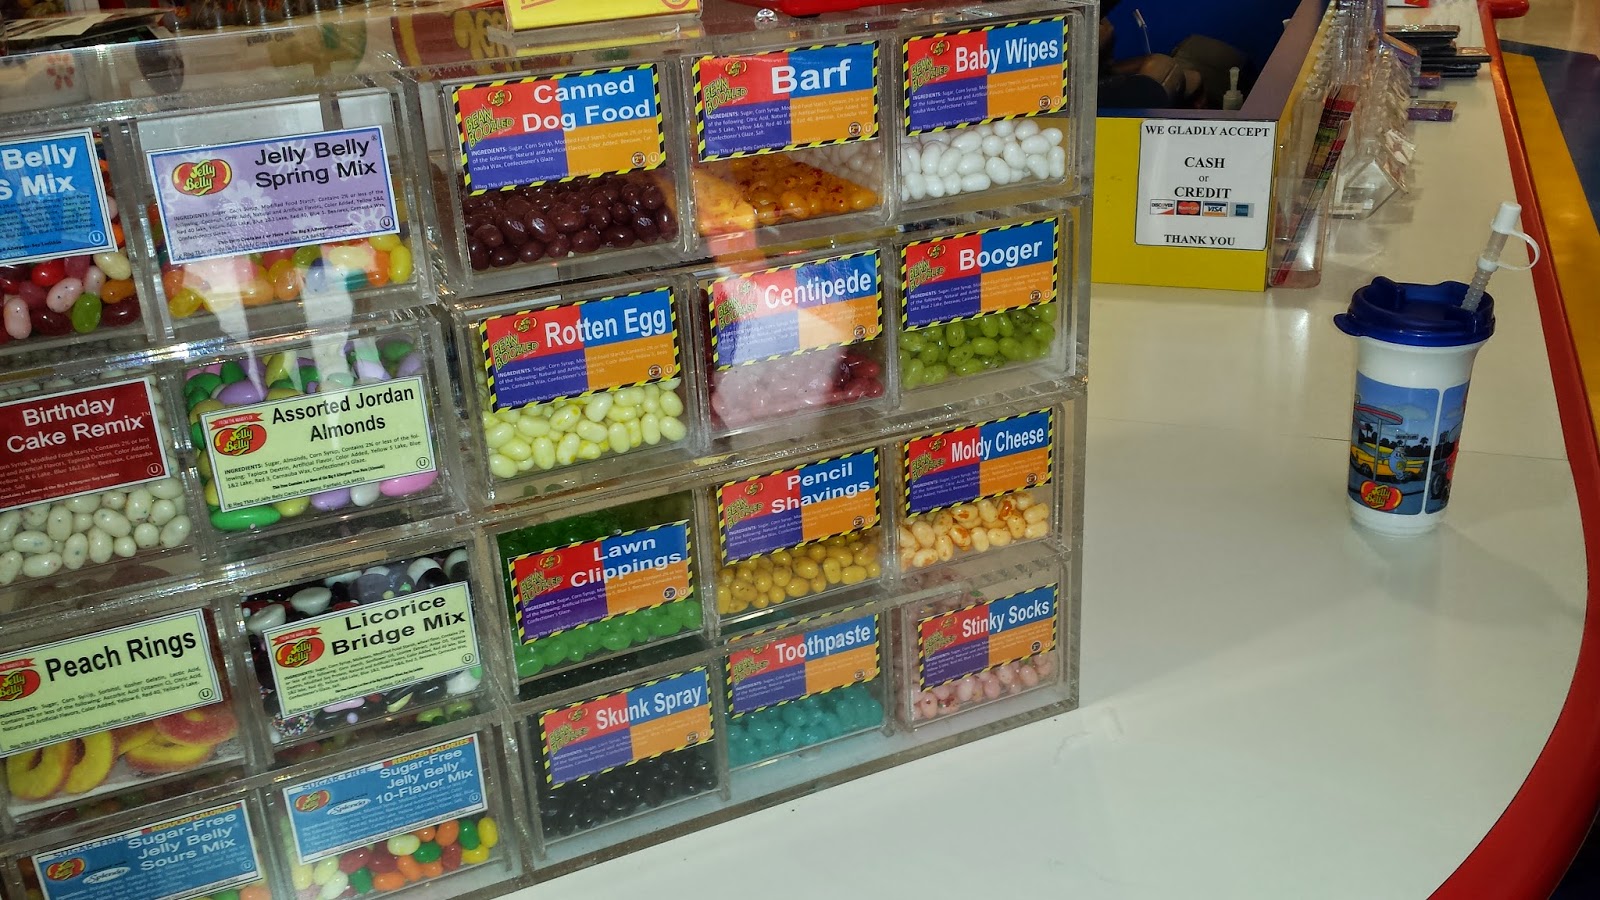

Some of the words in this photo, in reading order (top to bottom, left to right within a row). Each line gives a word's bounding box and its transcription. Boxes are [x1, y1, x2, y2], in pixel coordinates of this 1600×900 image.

[955, 43, 1000, 74] Baby
[1005, 37, 1058, 68] Wipes
[533, 75, 635, 104] Canned
[703, 77, 730, 101] BEAN
[771, 58, 852, 94] Barf
[464, 106, 494, 133] BEAN
[522, 112, 577, 132] Dog
[584, 99, 650, 124] Food
[1145, 125, 1164, 135] WE
[1167, 125, 1217, 136] GLADLY
[1219, 126, 1270, 137] ACCEPT
[1, 143, 77, 170] Belly
[190, 162, 217, 179] Jelly
[255, 146, 306, 166] Jelly
[1184, 156, 1225, 169] CASH
[21, 173, 76, 197] Mix
[183, 177, 213, 193] Belly
[255, 168, 330, 190] Spring
[336, 160, 377, 178] Mix
[1174, 186, 1231, 199] CREDIT
[1164, 234, 1206, 245] THANK
[1210, 236, 1235, 246] YOU
[959, 240, 1043, 271] Booger
[764, 268, 872, 309] Centipede
[544, 317, 618, 348] Rotten
[623, 307, 666, 337] Egg
[491, 333, 519, 358] BEAN
[22, 397, 115, 426] Birthday
[272, 395, 351, 425] Assorted
[355, 387, 414, 409] Jordan
[6, 430, 67, 453] Cake
[230, 426, 253, 442] Jelly
[310, 415, 386, 442] Almonds
[223, 439, 250, 453] Belly
[224, 463, 263, 475] INGREDIENTS:
[309, 451, 322, 459] Corn
[341, 443, 364, 453] Contains
[400, 434, 409, 442] the
[951, 436, 992, 463] Moldy
[995, 427, 1044, 452] Cheese
[247, 469, 268, 479] Tapioca
[292, 458, 315, 469] Artificial
[335, 453, 350, 461] Color
[370, 446, 388, 454] Yellow
[787, 461, 853, 491] Pencil
[255, 476, 267, 484] Red
[1372, 486, 1391, 499] Jelly
[771, 480, 871, 514] Shavings
[1366, 493, 1386, 505] Belly
[593, 537, 657, 562] Lawn
[570, 552, 682, 588] Clippings
[345, 597, 446, 631] Licorice
[962, 612, 1005, 638] Stinky
[1008, 599, 1050, 625] Socks
[291, 640, 313, 655] Jelly
[331, 625, 415, 656] Bridge
[423, 611, 466, 632] Mix
[775, 624, 871, 664] Toothpaste
[44, 645, 122, 682] Peach
[126, 632, 197, 662] Rings
[285, 652, 310, 665] Belly
[2, 673, 25, 687] Jelly
[595, 697, 651, 730] Skunk
[654, 685, 702, 715] Spray
[379, 748, 463, 779] Sugar-Free
[391, 750, 430, 765] REDUCED
[430, 738, 470, 754] CALORIES
[375, 779, 445, 804] 10-Flavor
[447, 768, 473, 783] Mix
[386, 771, 420, 789] Jelly
[424, 761, 459, 779] Belly
[127, 813, 237, 849] Sugar-Free
[137, 839, 180, 860] Jelly
[186, 826, 233, 847] Belly
[140, 850, 197, 871] Sours
[202, 837, 236, 855] Mix
